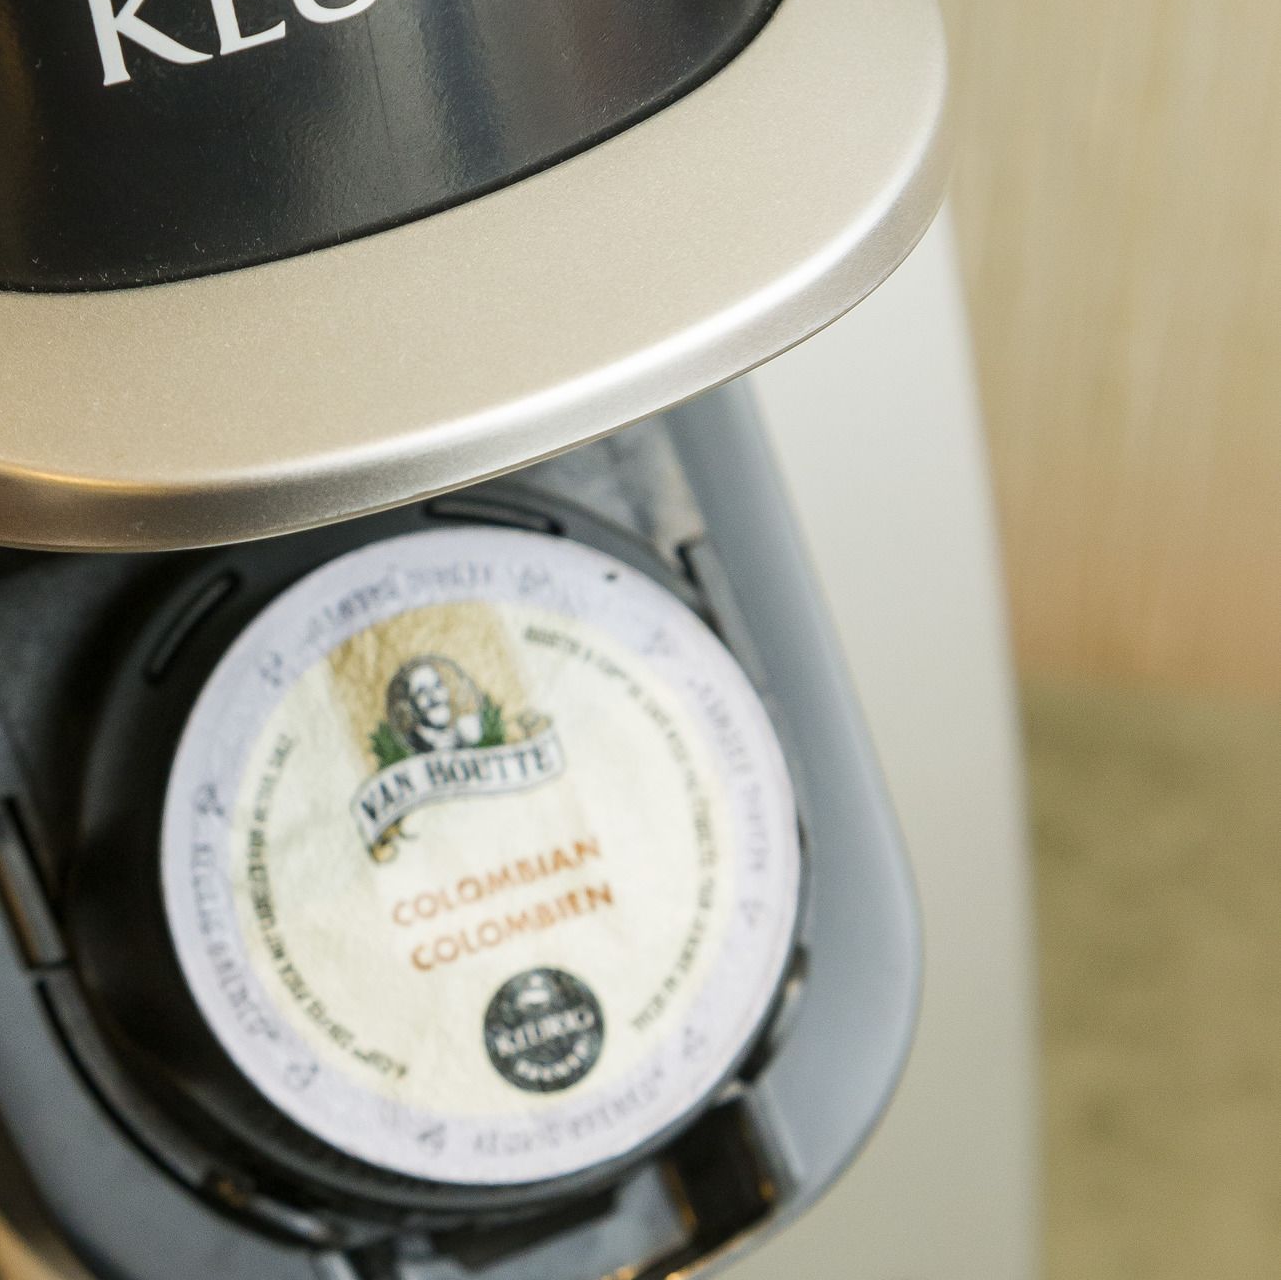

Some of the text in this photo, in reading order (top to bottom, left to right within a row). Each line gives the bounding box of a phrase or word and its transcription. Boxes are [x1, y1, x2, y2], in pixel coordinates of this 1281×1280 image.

[360, 742, 555, 822] VAN HOUTTE
[392, 835, 602, 928] COLOMBIAN
[411, 880, 615, 972] COLOMBIEN
